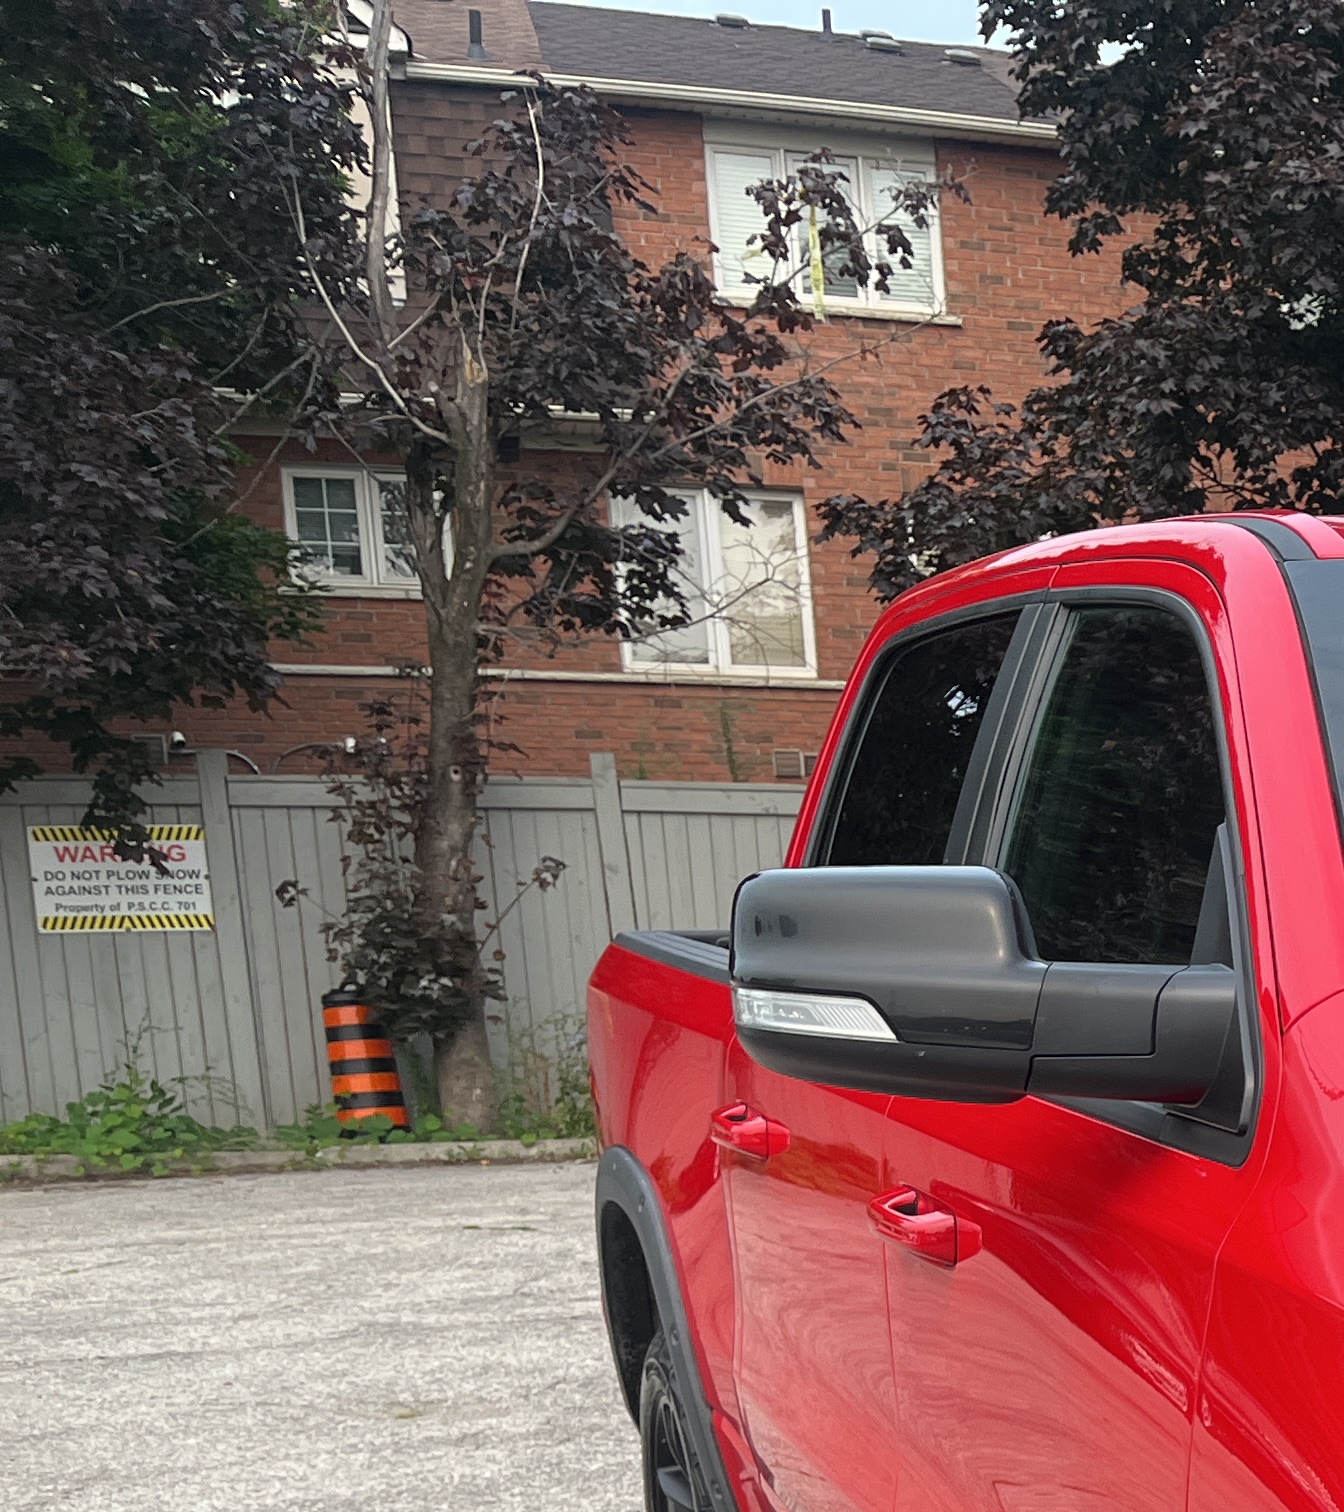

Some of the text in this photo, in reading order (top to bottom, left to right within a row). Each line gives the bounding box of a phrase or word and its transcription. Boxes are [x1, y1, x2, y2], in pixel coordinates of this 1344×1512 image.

[53, 844, 187, 863] WARG
[44, 868, 201, 882] DO NOT PLOW SNOW
[44, 883, 204, 896] AGAINST THIS FENCE
[55, 902, 105, 914] Property
[109, 902, 121, 912] of
[177, 901, 197, 911] 701
